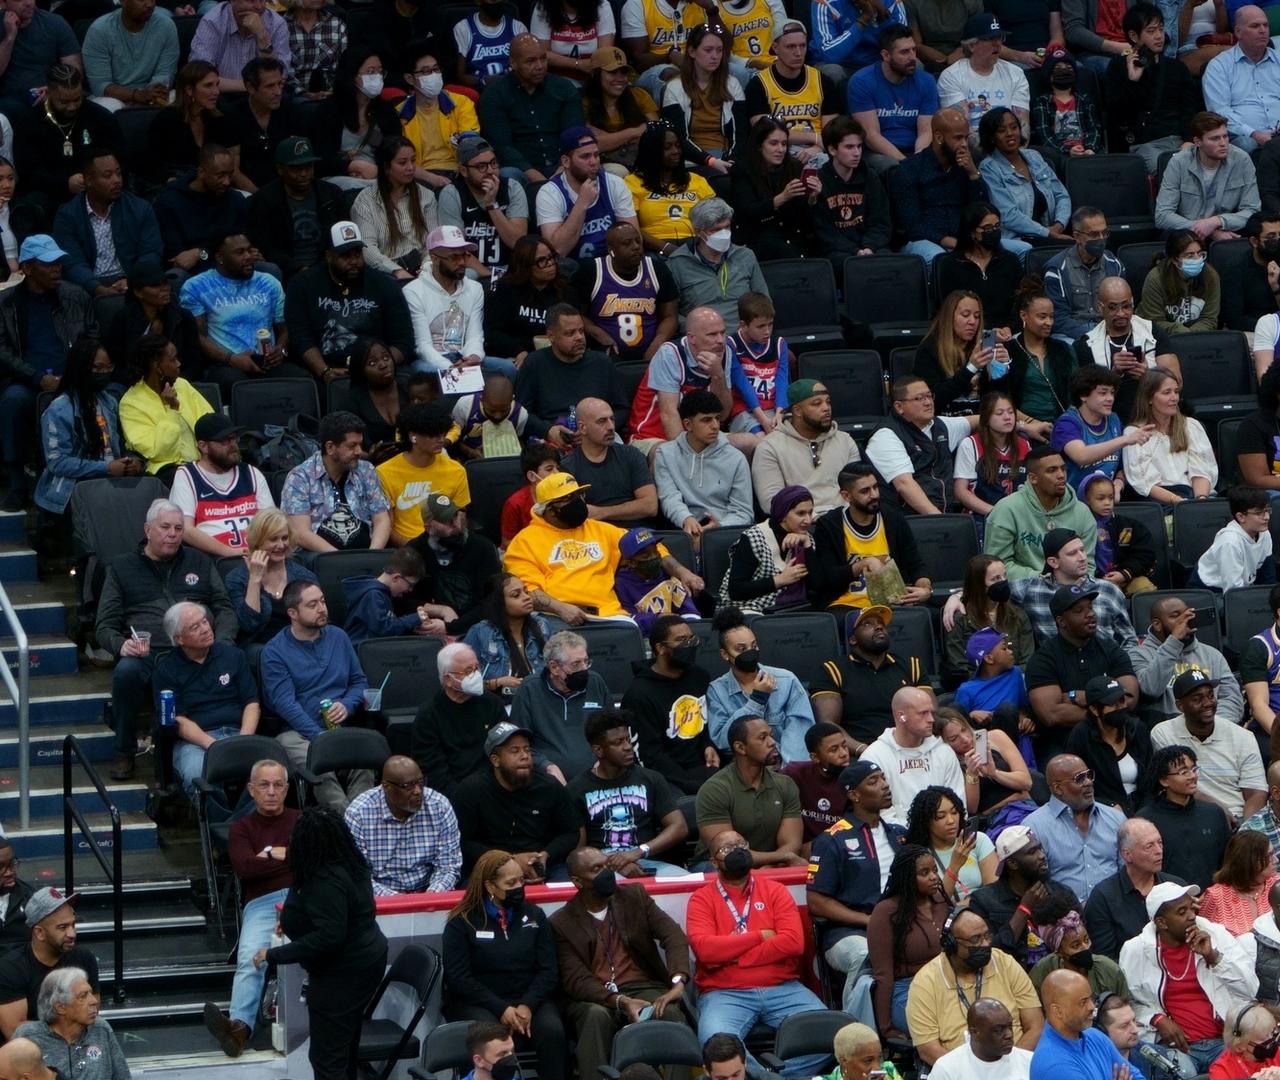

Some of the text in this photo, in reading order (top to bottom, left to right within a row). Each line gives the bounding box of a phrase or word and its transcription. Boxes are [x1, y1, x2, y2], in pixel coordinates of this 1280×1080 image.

[731, 17, 769, 38] LAKERS
[747, 35, 762, 55] 6
[769, 102, 820, 119] LAKERS
[581, 215, 612, 230] KERS
[214, 292, 269, 307] ALUMNI
[599, 294, 656, 317] LAKERS
[616, 313, 643, 347] 8
[403, 480, 432, 498] NIKE
[553, 544, 601, 561] LAKERS
[899, 758, 929, 774] LAKERS
